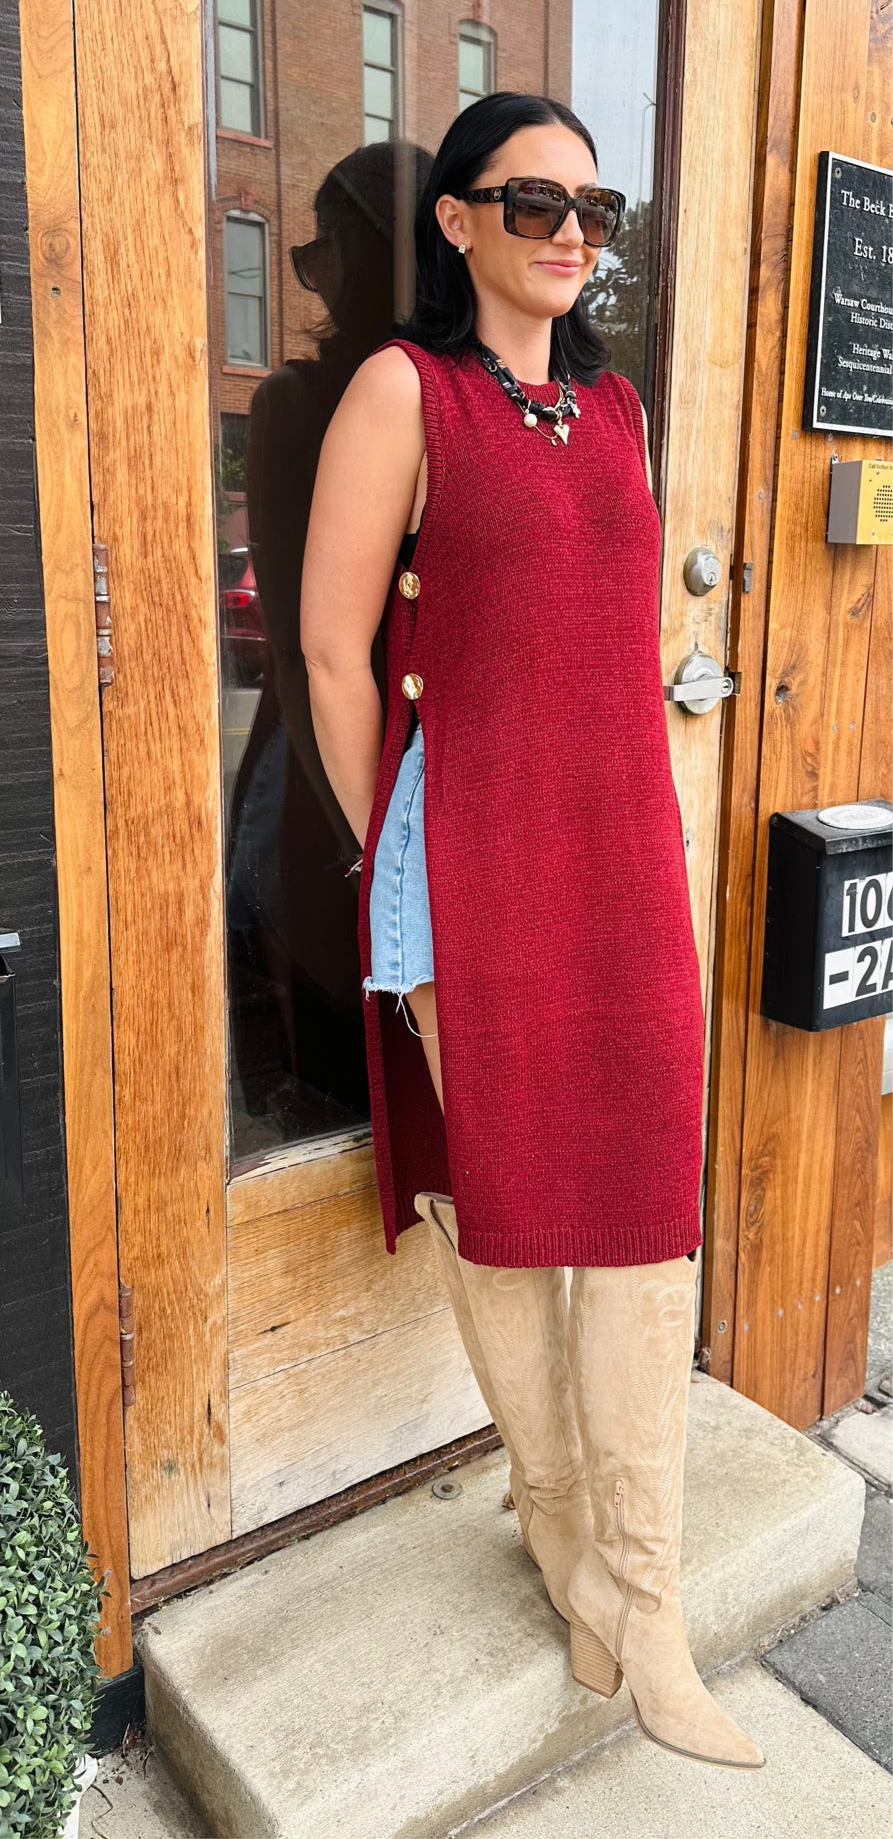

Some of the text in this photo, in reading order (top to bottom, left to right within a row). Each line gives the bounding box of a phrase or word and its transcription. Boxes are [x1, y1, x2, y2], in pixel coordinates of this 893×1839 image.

[841, 190, 860, 209] The
[863, 196, 886, 216] Beck
[854, 237, 893, 264] Est. 18
[834, 293, 860, 308] Warsaw
[850, 311, 878, 327] Historic
[852, 343, 881, 360] Heritage
[838, 357, 892, 375] Sesquicentennial
[821, 387, 836, 398] Home
[836, 390, 843, 398] of
[852, 391, 863, 401] Over
[846, 878, 893, 933] 10
